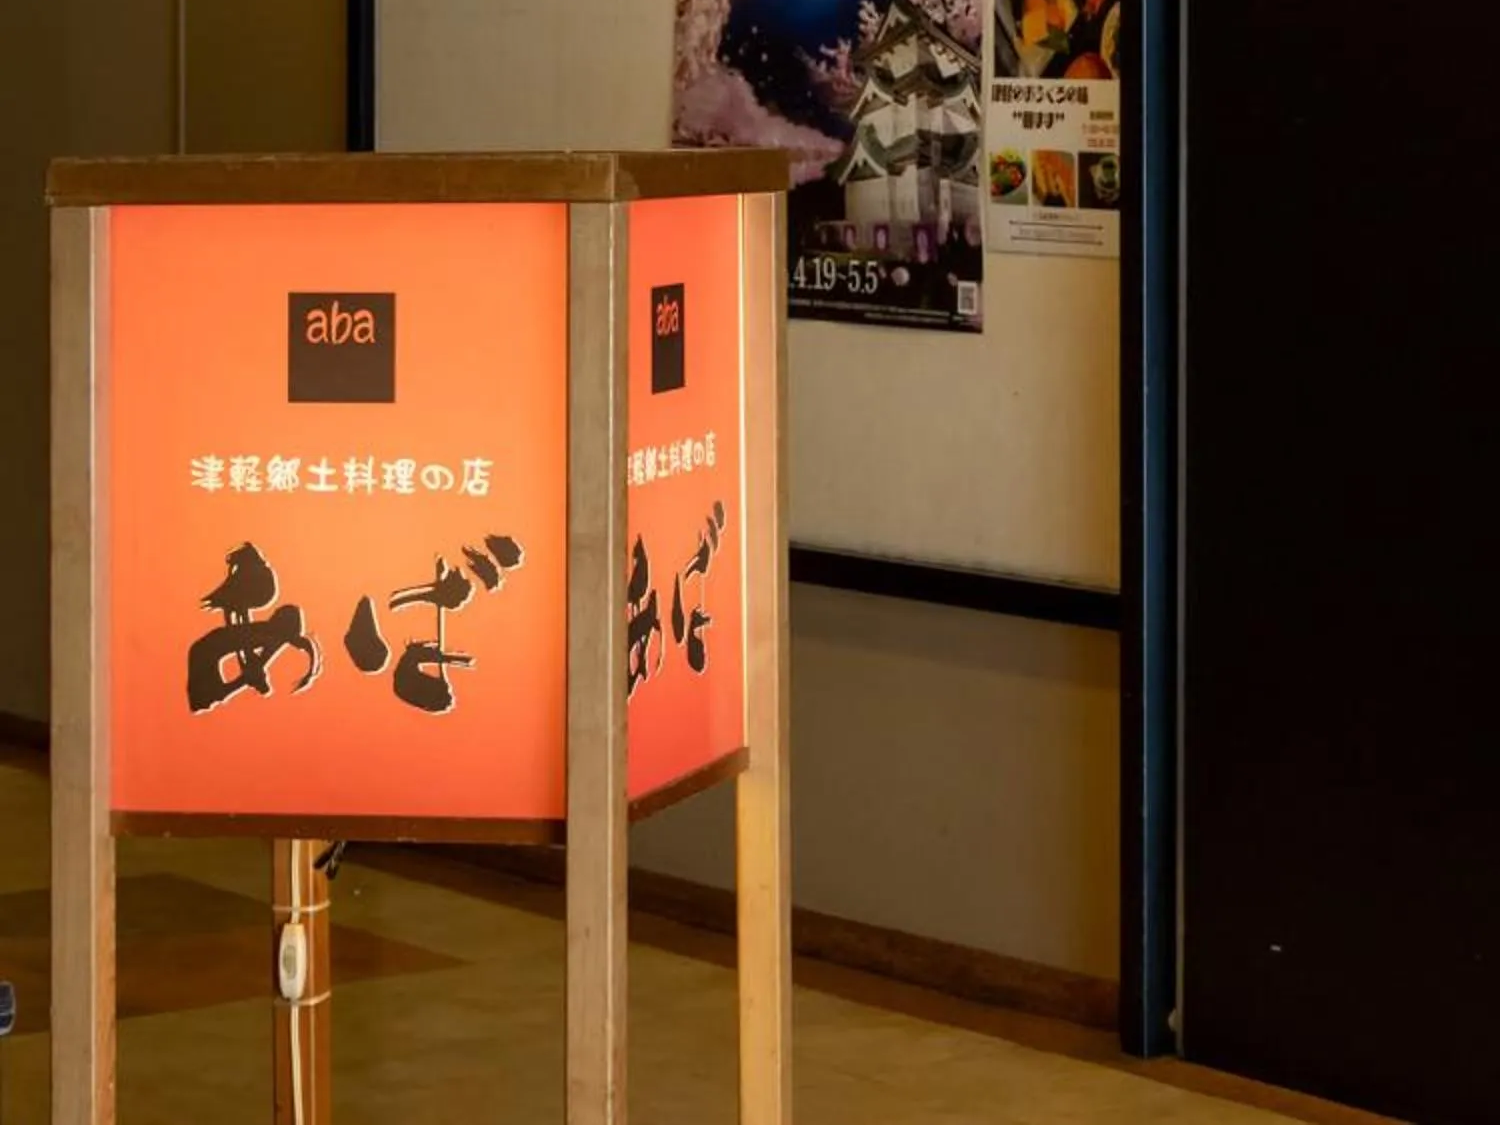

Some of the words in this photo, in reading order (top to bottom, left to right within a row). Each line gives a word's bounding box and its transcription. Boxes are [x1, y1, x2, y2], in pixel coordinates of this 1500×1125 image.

[306, 301, 377, 344] aba
[655, 294, 680, 336] aba
[190, 453, 495, 496] 津軽郷土料理の店
